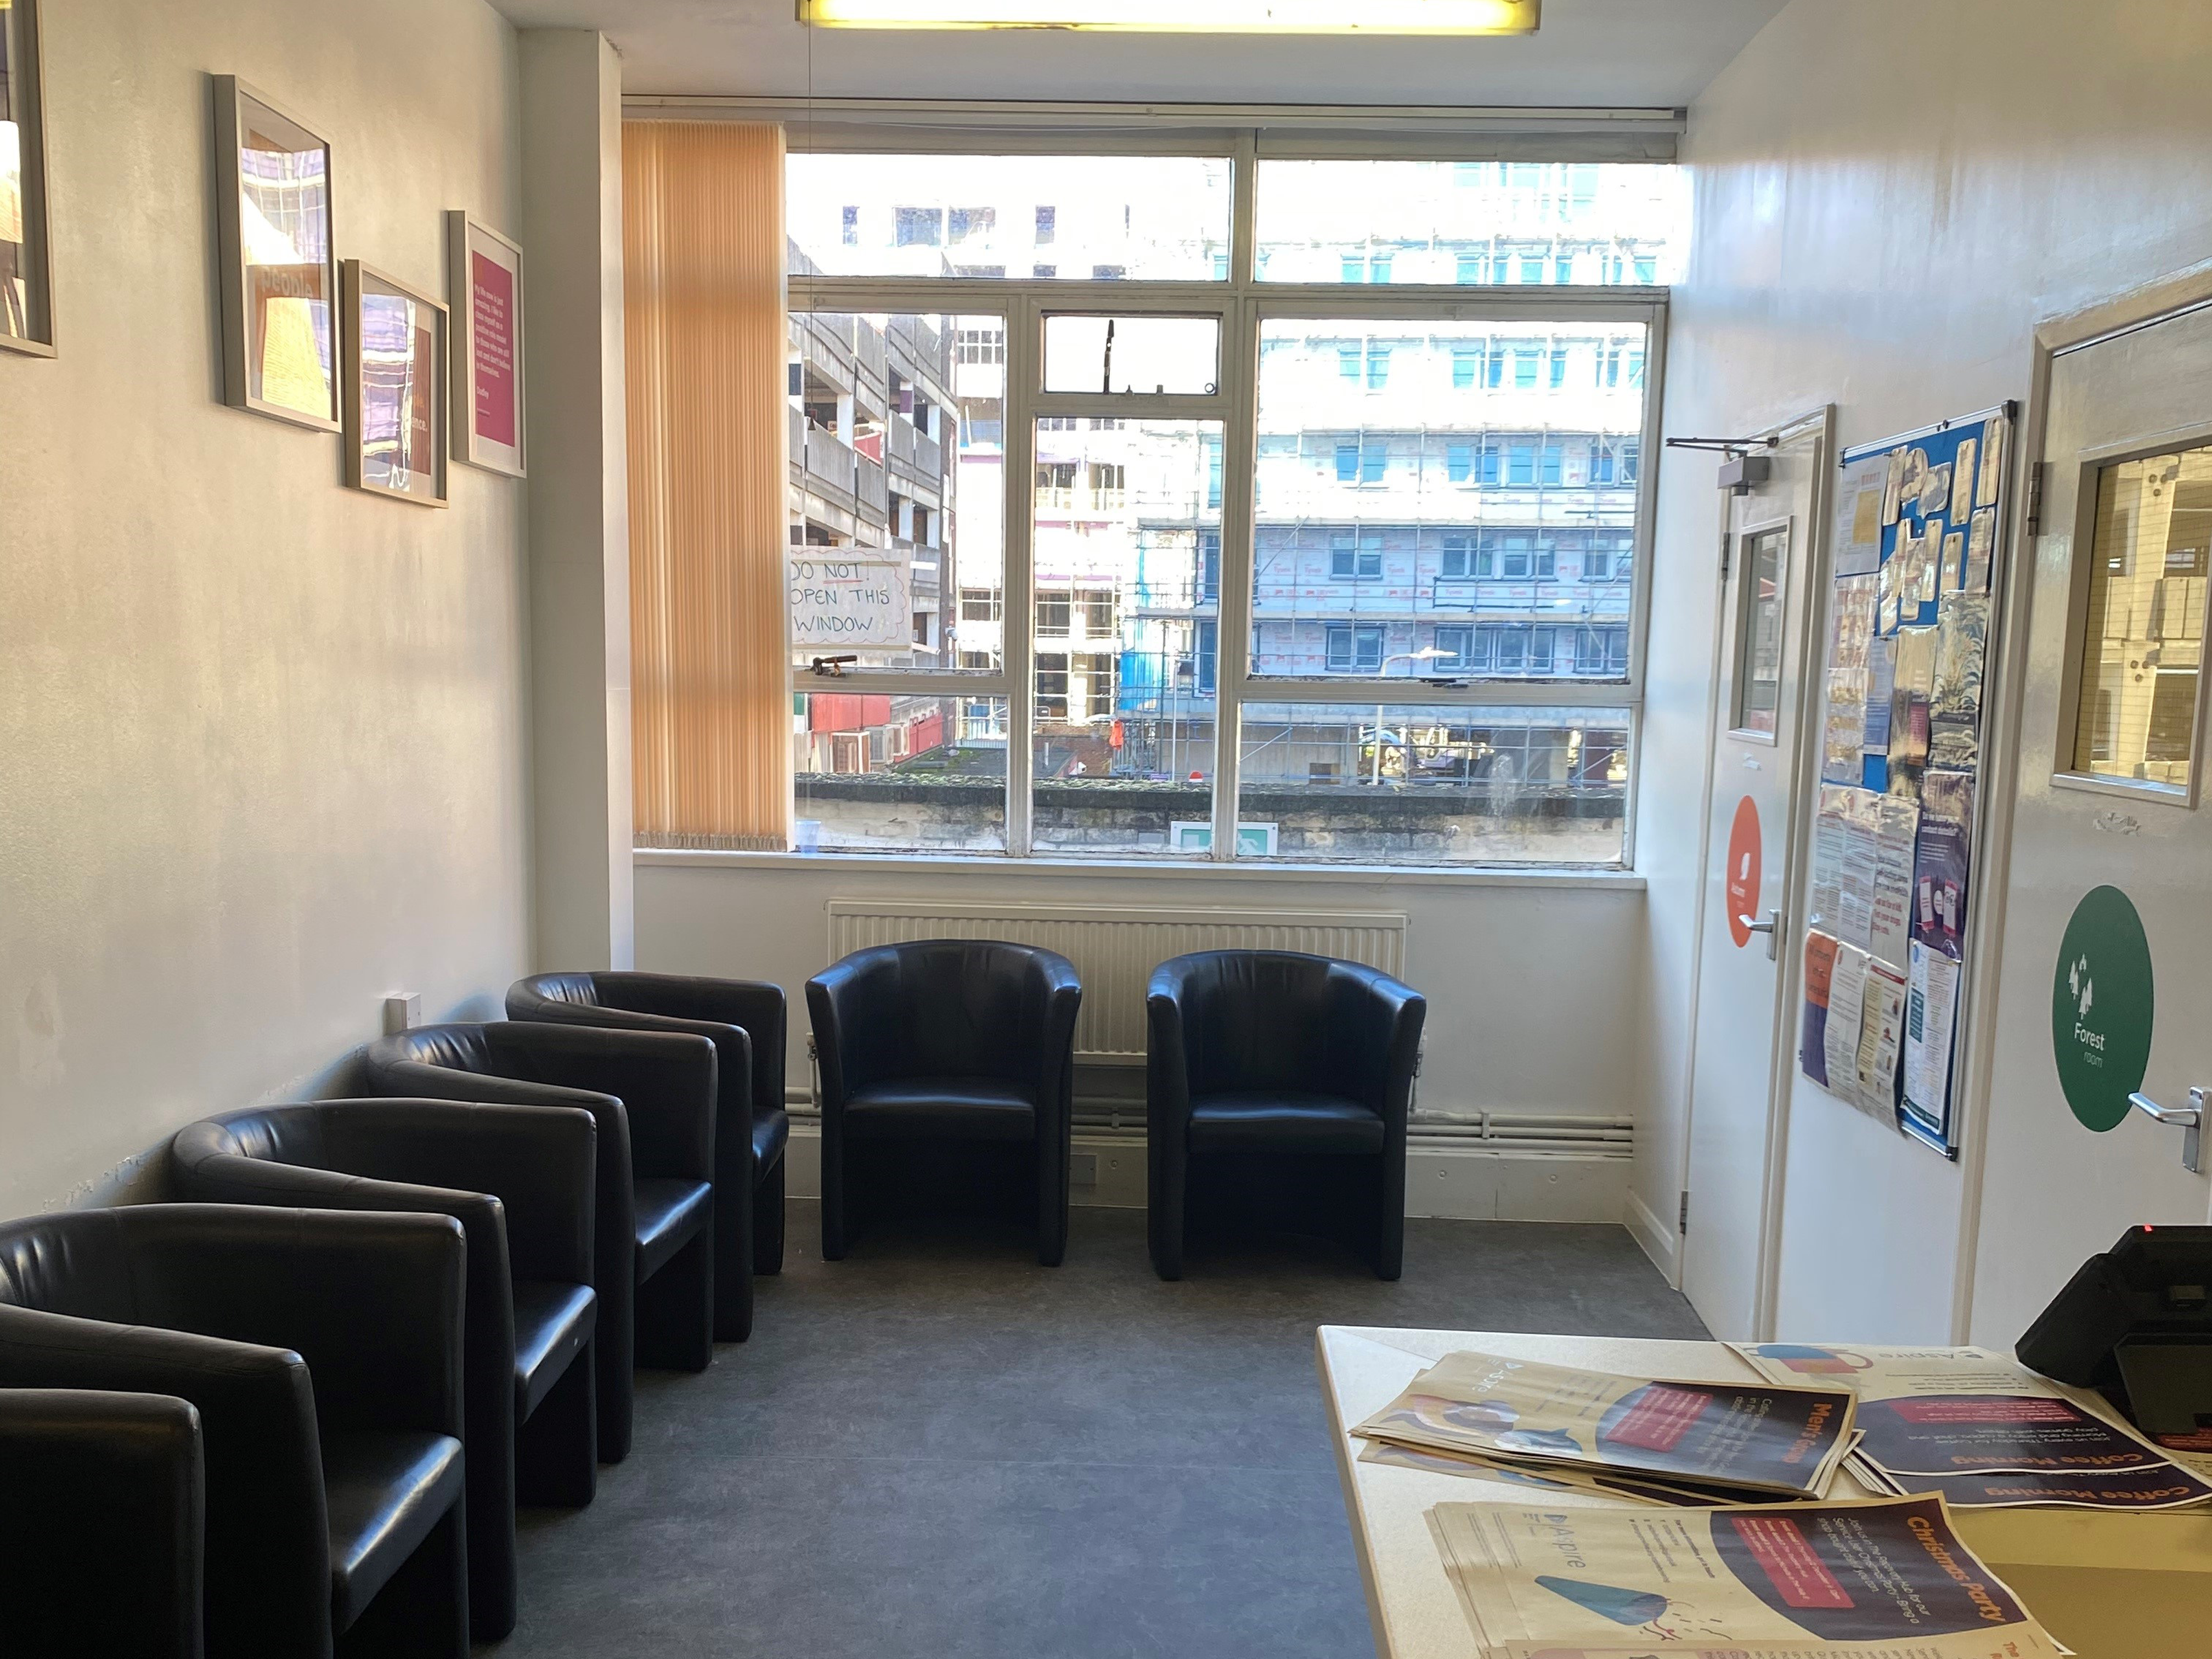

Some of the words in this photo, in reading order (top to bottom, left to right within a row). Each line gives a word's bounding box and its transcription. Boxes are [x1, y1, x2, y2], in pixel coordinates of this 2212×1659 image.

[791, 561, 814, 580] DO
[791, 589, 837, 605] OPEN
[849, 590, 889, 605] THIS
[793, 616, 873, 632] WINDOW
[2074, 1022, 2105, 1051] Forest
[2084, 1052, 2103, 1068] room
[1802, 1403, 1832, 1438] Men's
[1951, 1456, 2058, 1465] Morning
[2059, 1454, 2143, 1465] Coffee
[1984, 1487, 2098, 1500] Morning
[2100, 1485, 2190, 1500] Coffee
[1846, 1518, 1864, 1530] Join
[1814, 1518, 1835, 1533] shop
[1826, 1534, 1850, 1553] bought
[1548, 1526, 1586, 1568] Aspire
[1868, 1545, 1884, 1555] The
[1831, 1518, 1857, 1539] Service
[1849, 1541, 1866, 1552] User
[1859, 1553, 1887, 1579] Christmas
[1879, 1580, 1900, 1596] Party
[1894, 1600, 1917, 1617] Bring
[1876, 1556, 1904, 1580] Recovery
[1908, 1516, 1971, 1581] Christmas
[1960, 1583, 2006, 1622] Party
[1897, 1582, 1915, 1593] Hub
[1907, 1594, 1922, 1602] for
[1914, 1603, 1932, 1615] our
